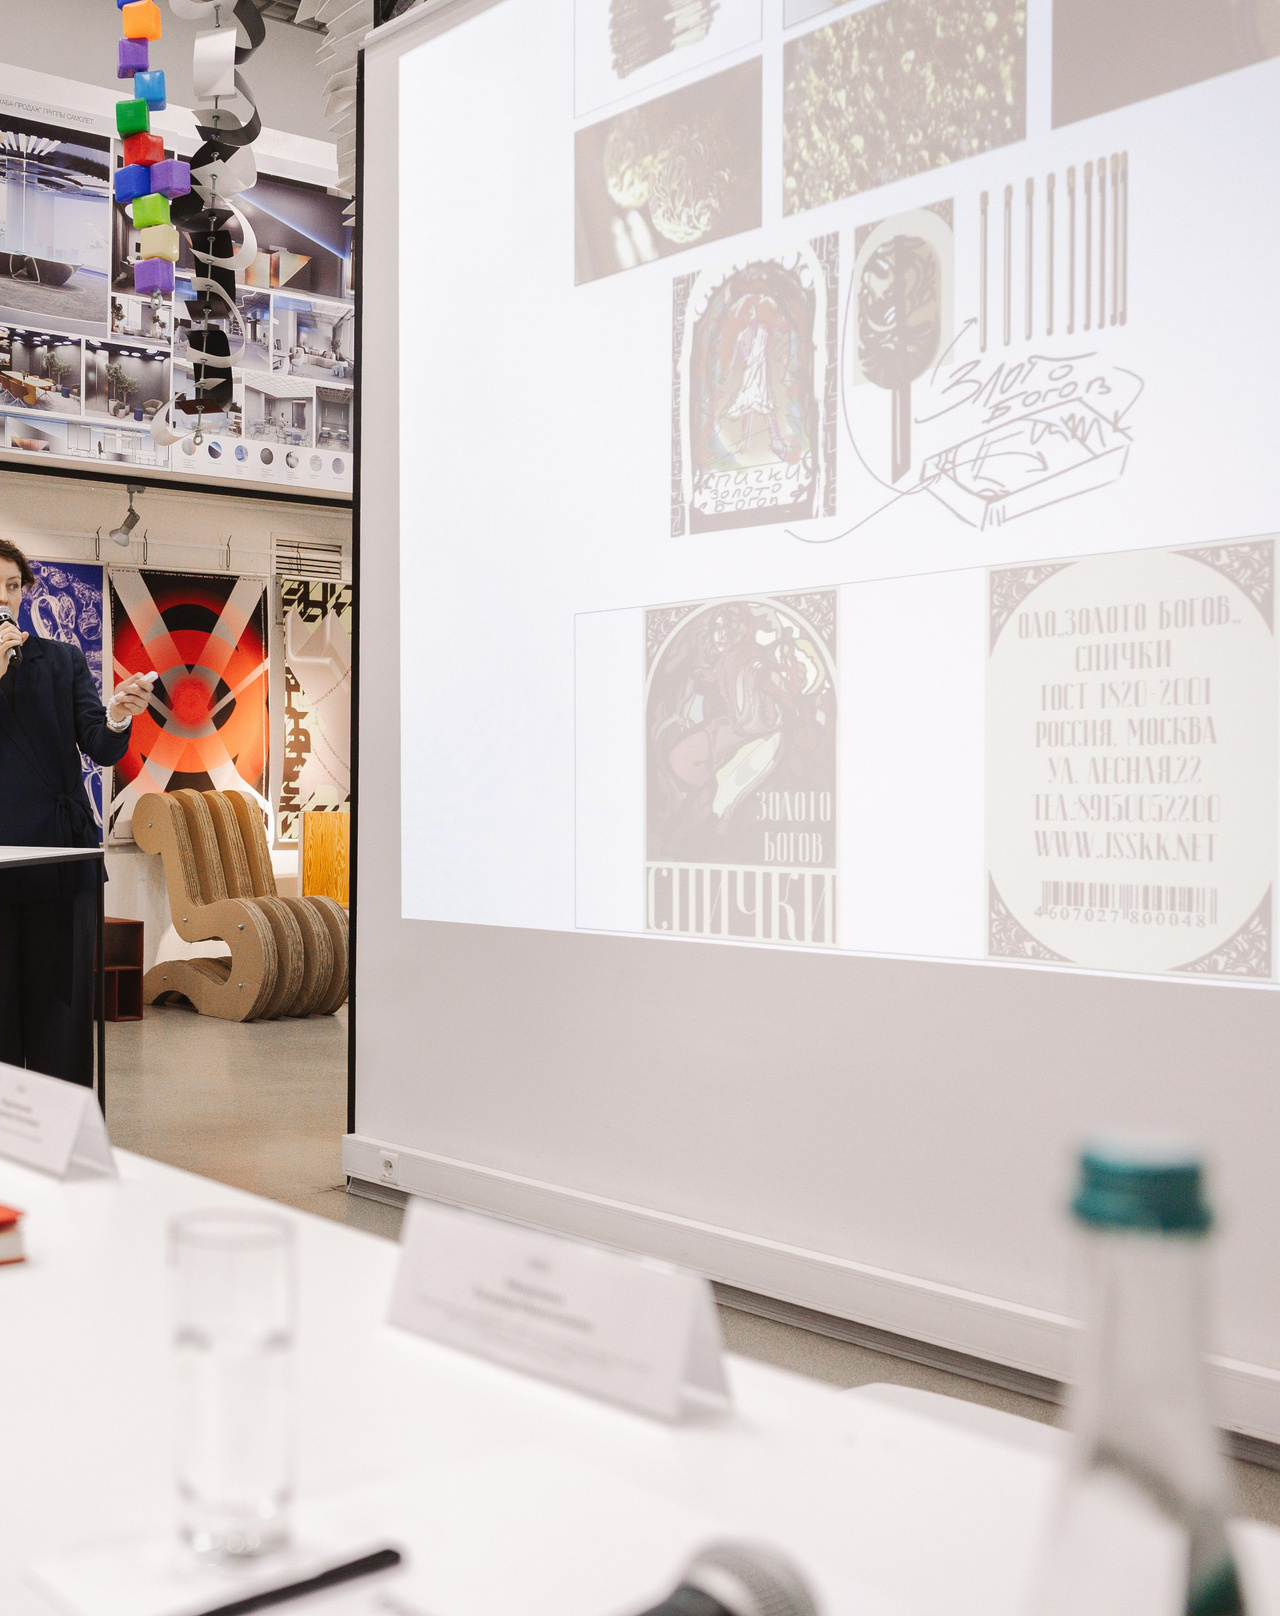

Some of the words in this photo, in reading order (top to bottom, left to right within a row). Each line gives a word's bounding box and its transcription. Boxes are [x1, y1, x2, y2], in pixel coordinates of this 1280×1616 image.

[43, 108, 66, 119] ГРУППЫ
[67, 113, 95, 125] САМОЛЕТ
[1074, 639, 1172, 672] СПИЧКИ
[1041, 682, 1088, 711] ГОСТ
[1100, 676, 1211, 710] 1820-2001
[1127, 715, 1218, 746] МОСКВА
[1048, 757, 1079, 785] УЛ.
[756, 790, 832, 822] ЗОЛОТО
[764, 831, 823, 863] БОГОВ
[647, 866, 833, 943] СПИЧКИ
